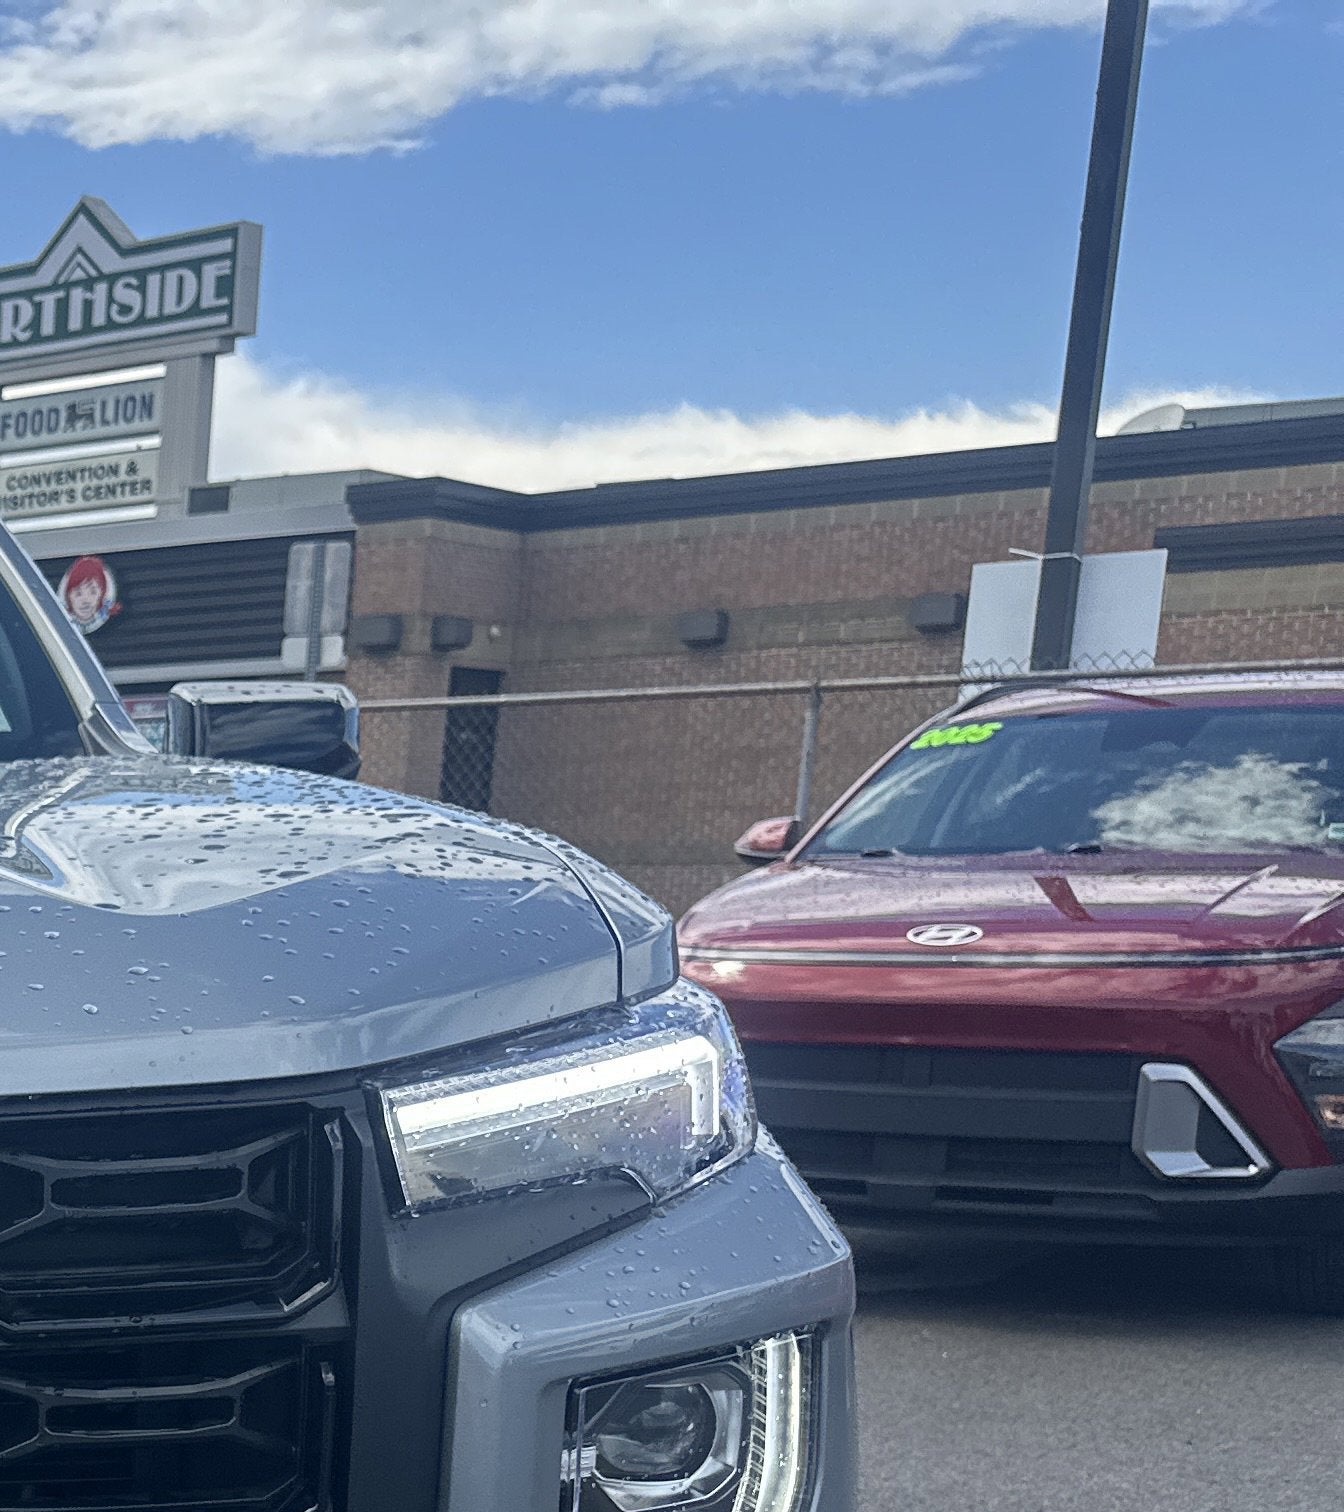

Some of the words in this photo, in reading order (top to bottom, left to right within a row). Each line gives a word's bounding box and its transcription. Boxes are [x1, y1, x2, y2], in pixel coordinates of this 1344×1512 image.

[0, 407, 60, 441] FOOD
[100, 391, 155, 427] LION
[5, 462, 120, 491] CONVENTION
[125, 458, 140, 477] &
[80, 478, 153, 501] CENTER
